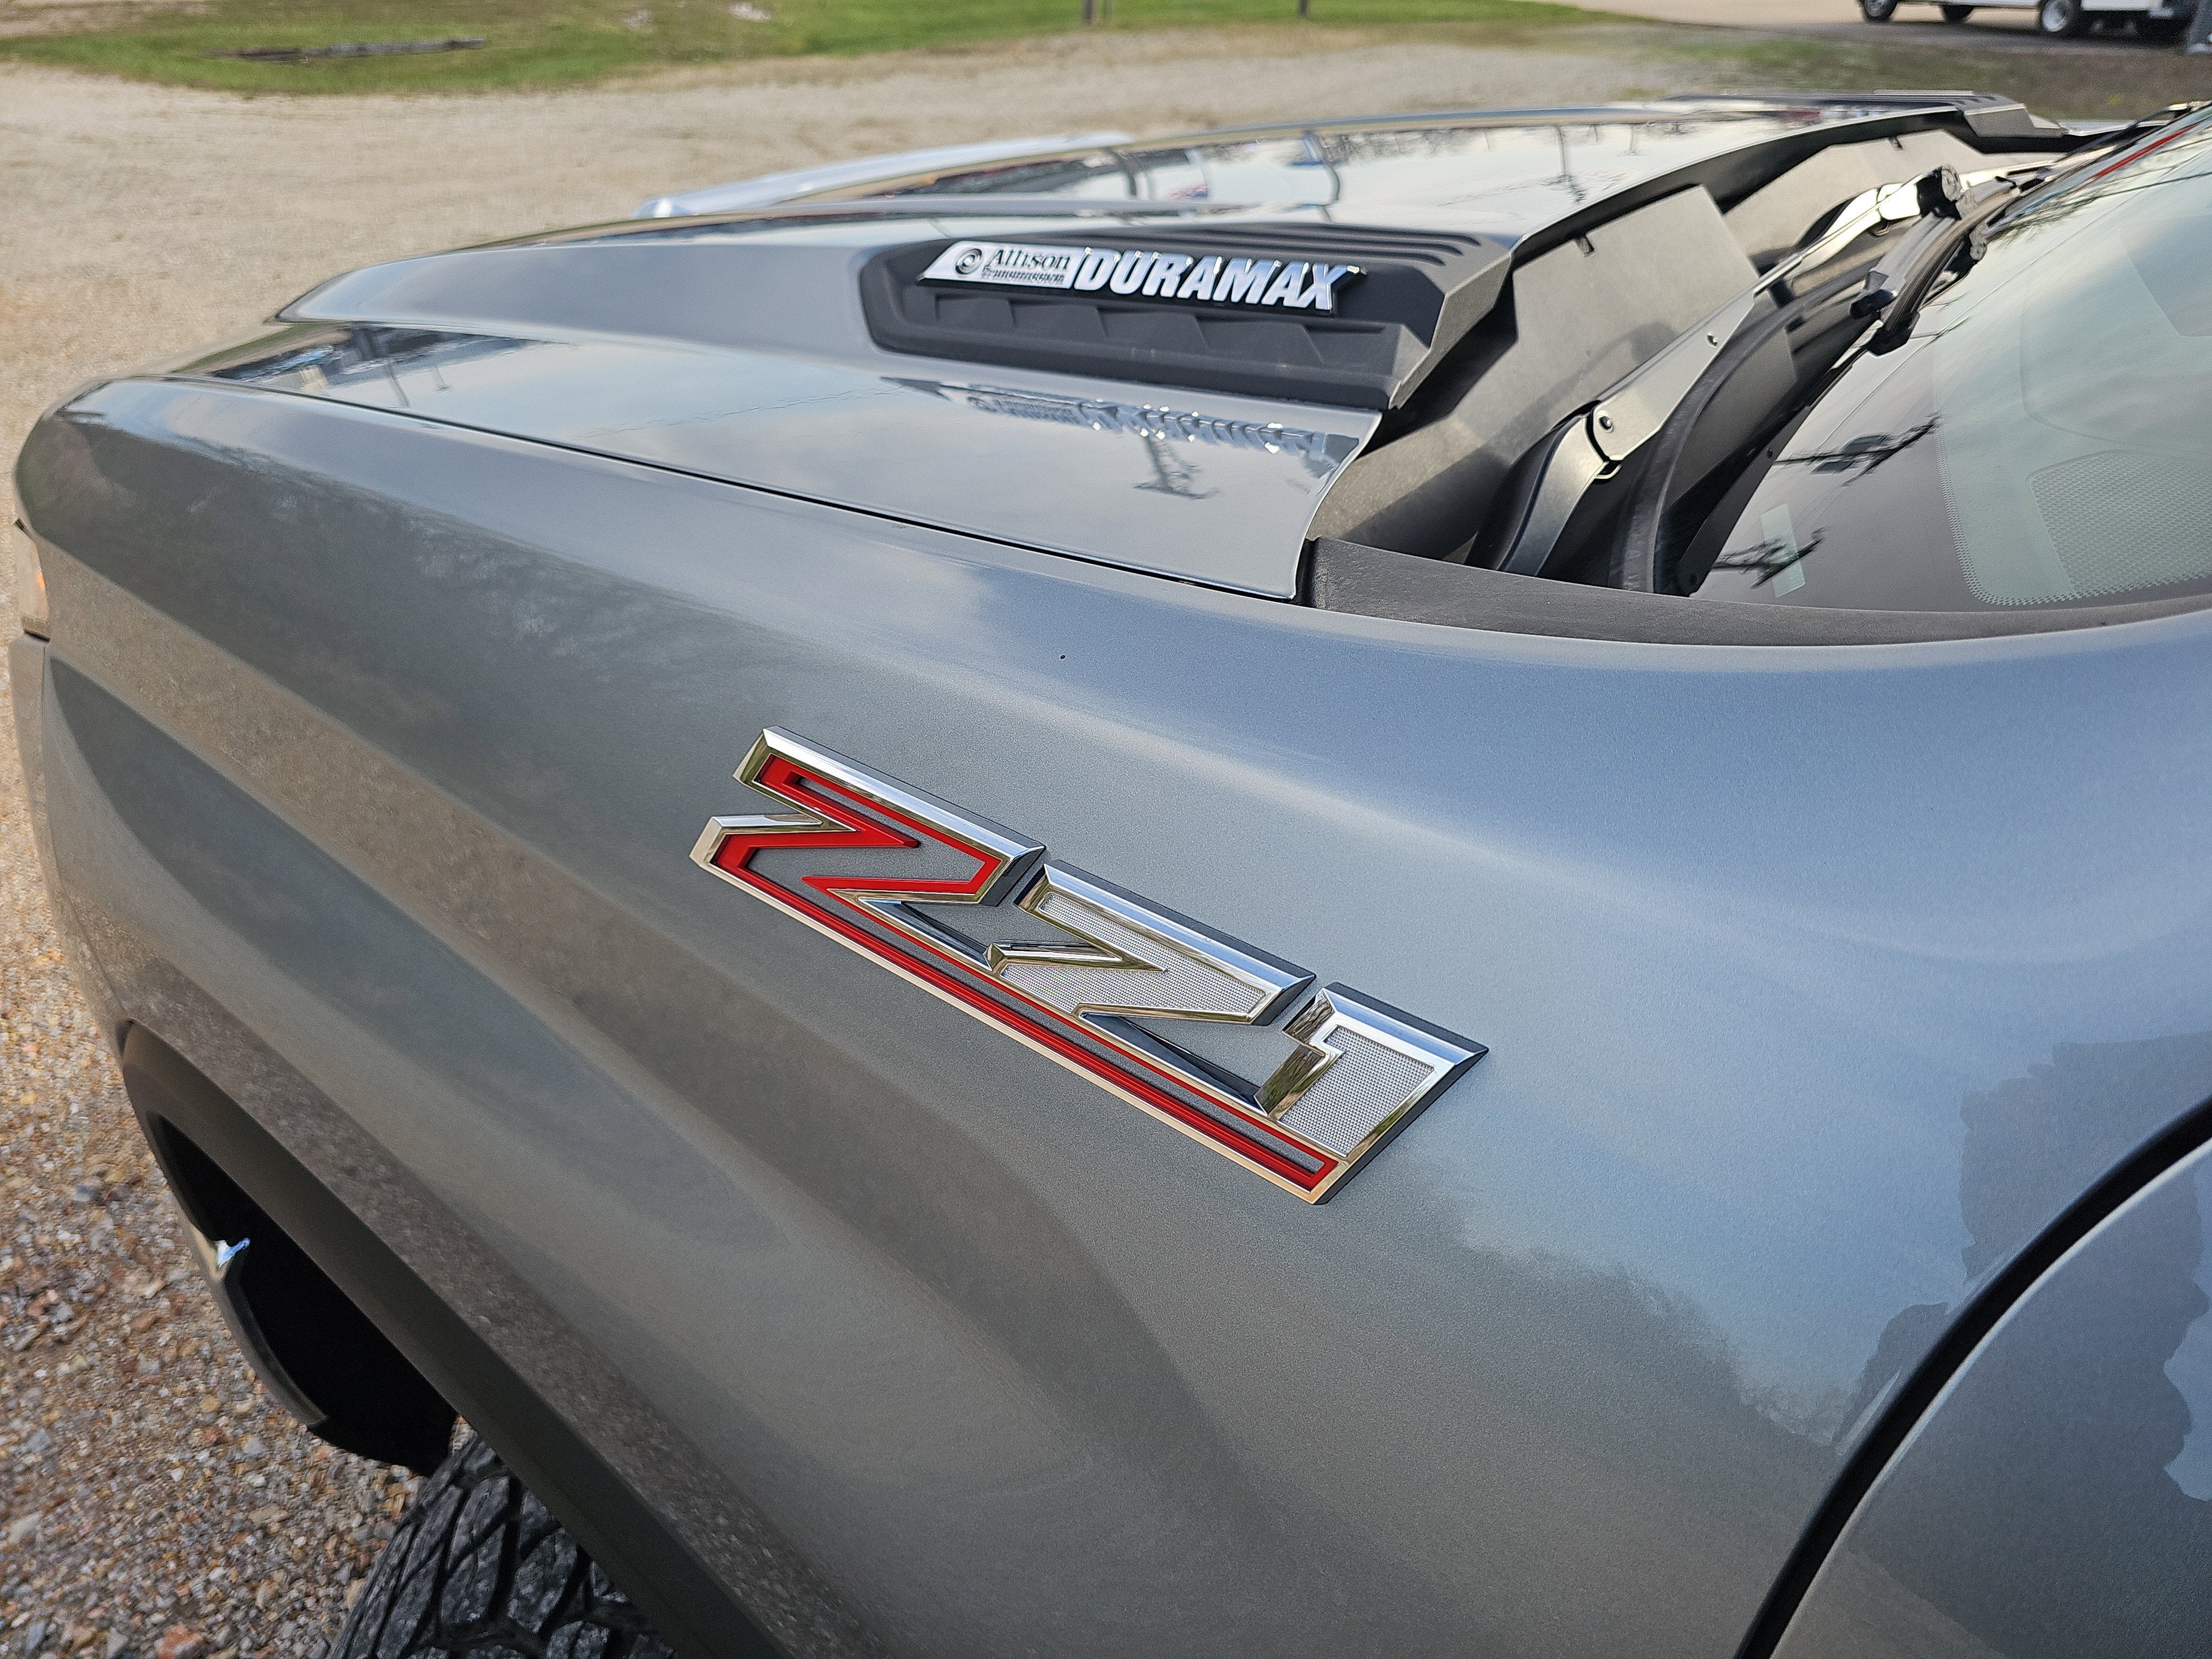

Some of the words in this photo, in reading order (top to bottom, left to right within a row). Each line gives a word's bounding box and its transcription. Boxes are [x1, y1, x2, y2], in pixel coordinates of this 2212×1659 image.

[987, 248, 1071, 271] Allison
[1073, 247, 1361, 312] DURAMAX
[690, 726, 1489, 1205] Z71
